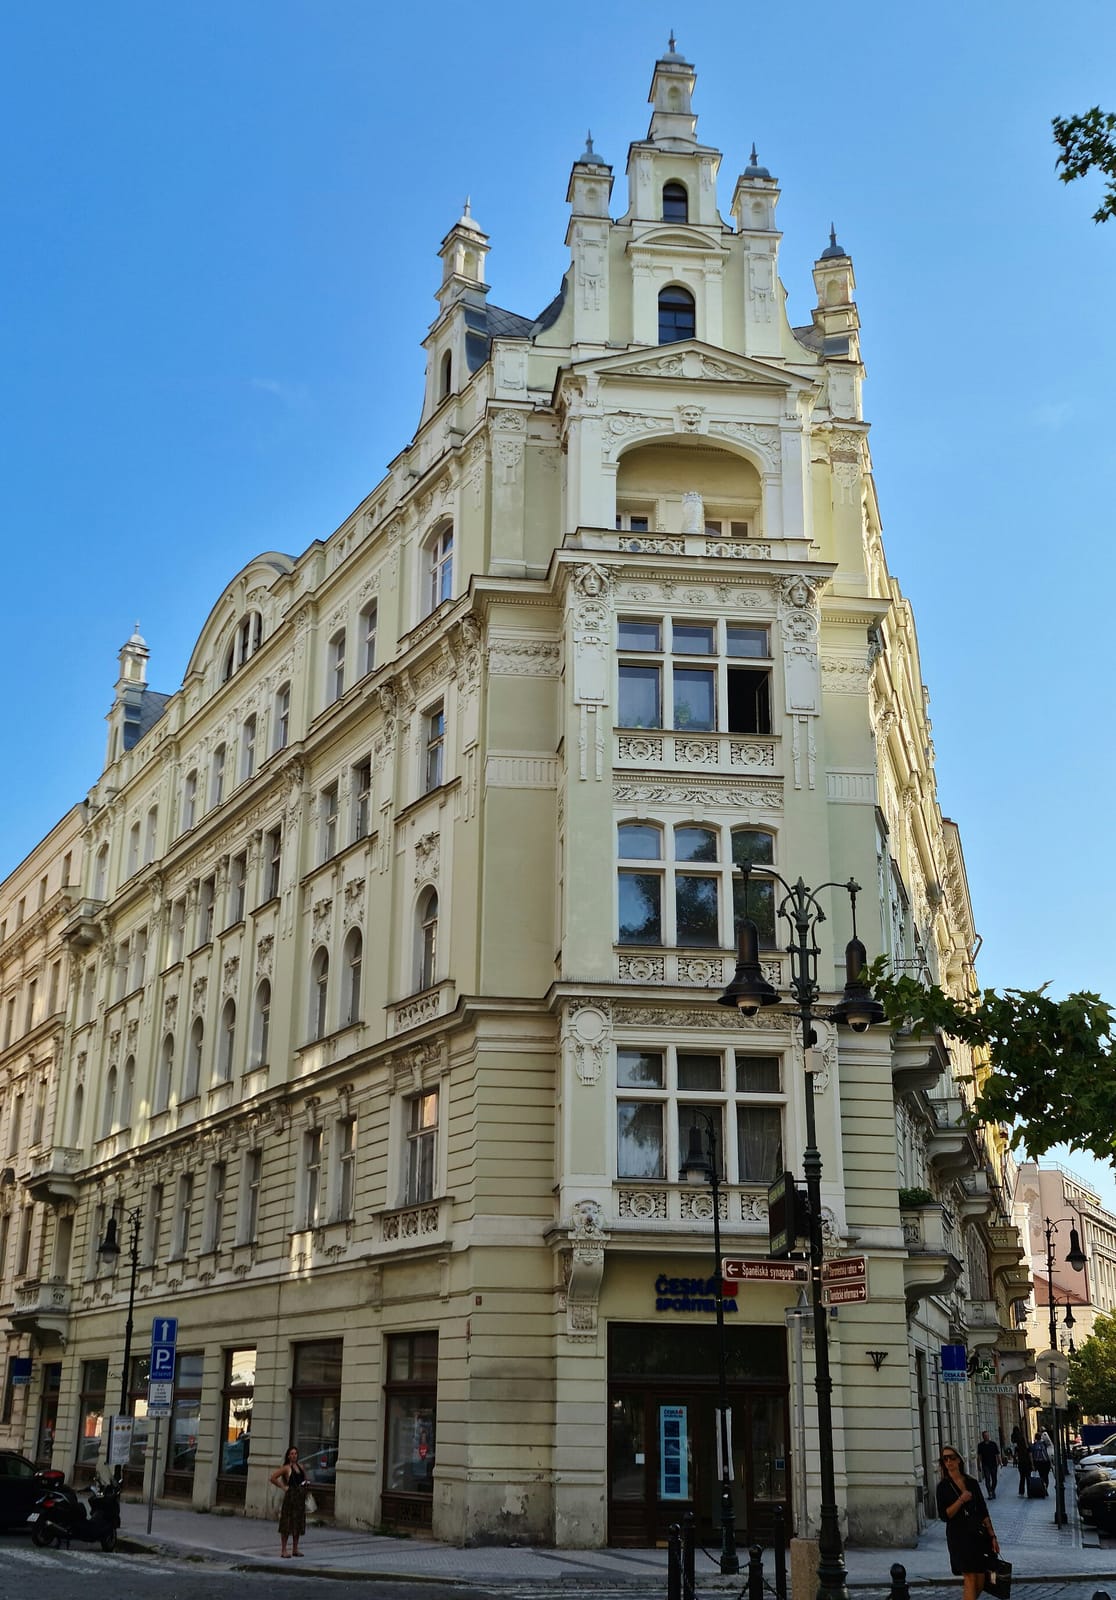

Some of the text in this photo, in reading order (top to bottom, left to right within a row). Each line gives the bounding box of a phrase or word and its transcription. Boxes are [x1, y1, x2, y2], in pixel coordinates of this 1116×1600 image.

[742, 1263, 794, 1280] Španělská synagoga
[656, 1273, 720, 1295] ČESKÁ
[155, 1349, 170, 1370] P
